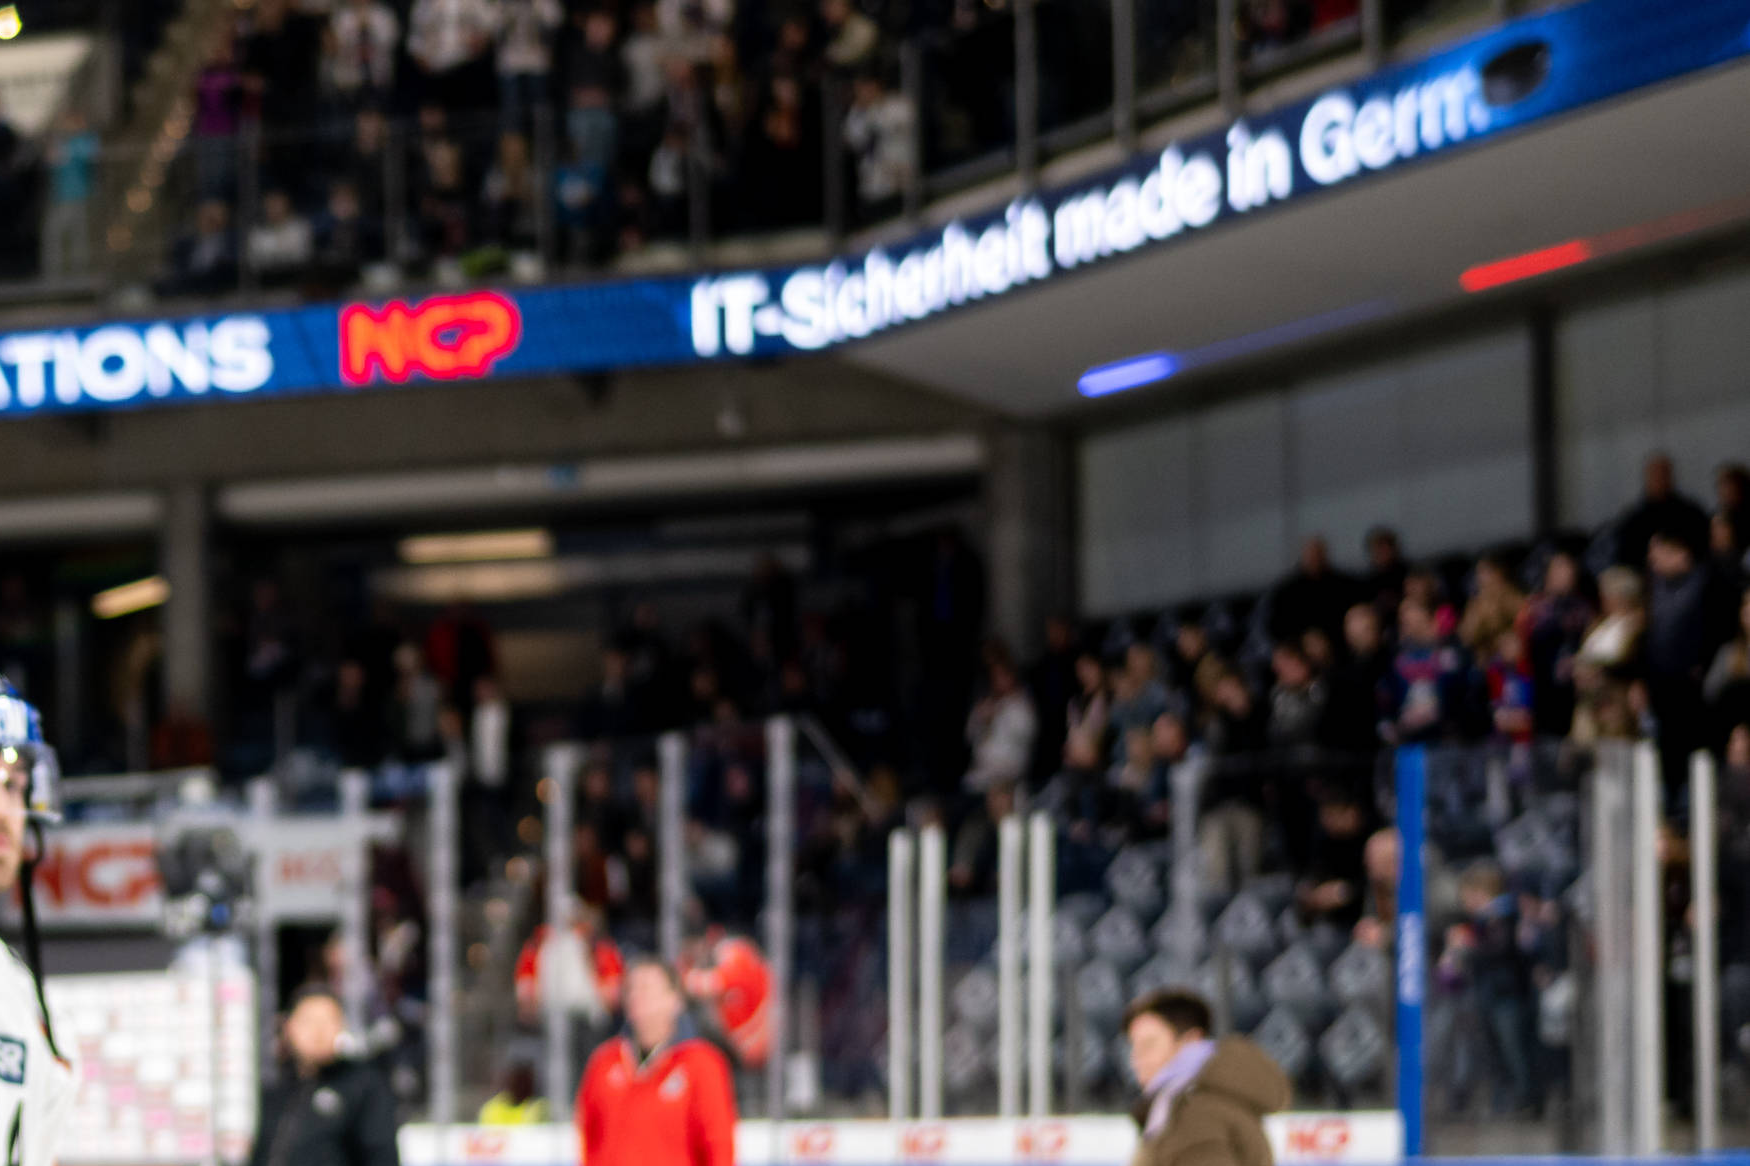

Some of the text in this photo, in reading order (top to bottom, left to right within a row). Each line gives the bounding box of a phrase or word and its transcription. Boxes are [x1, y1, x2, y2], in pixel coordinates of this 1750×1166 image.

[690, 195, 1050, 357] IT-Sicherheit
[1052, 143, 1222, 270] made
[1227, 121, 1293, 206] in
